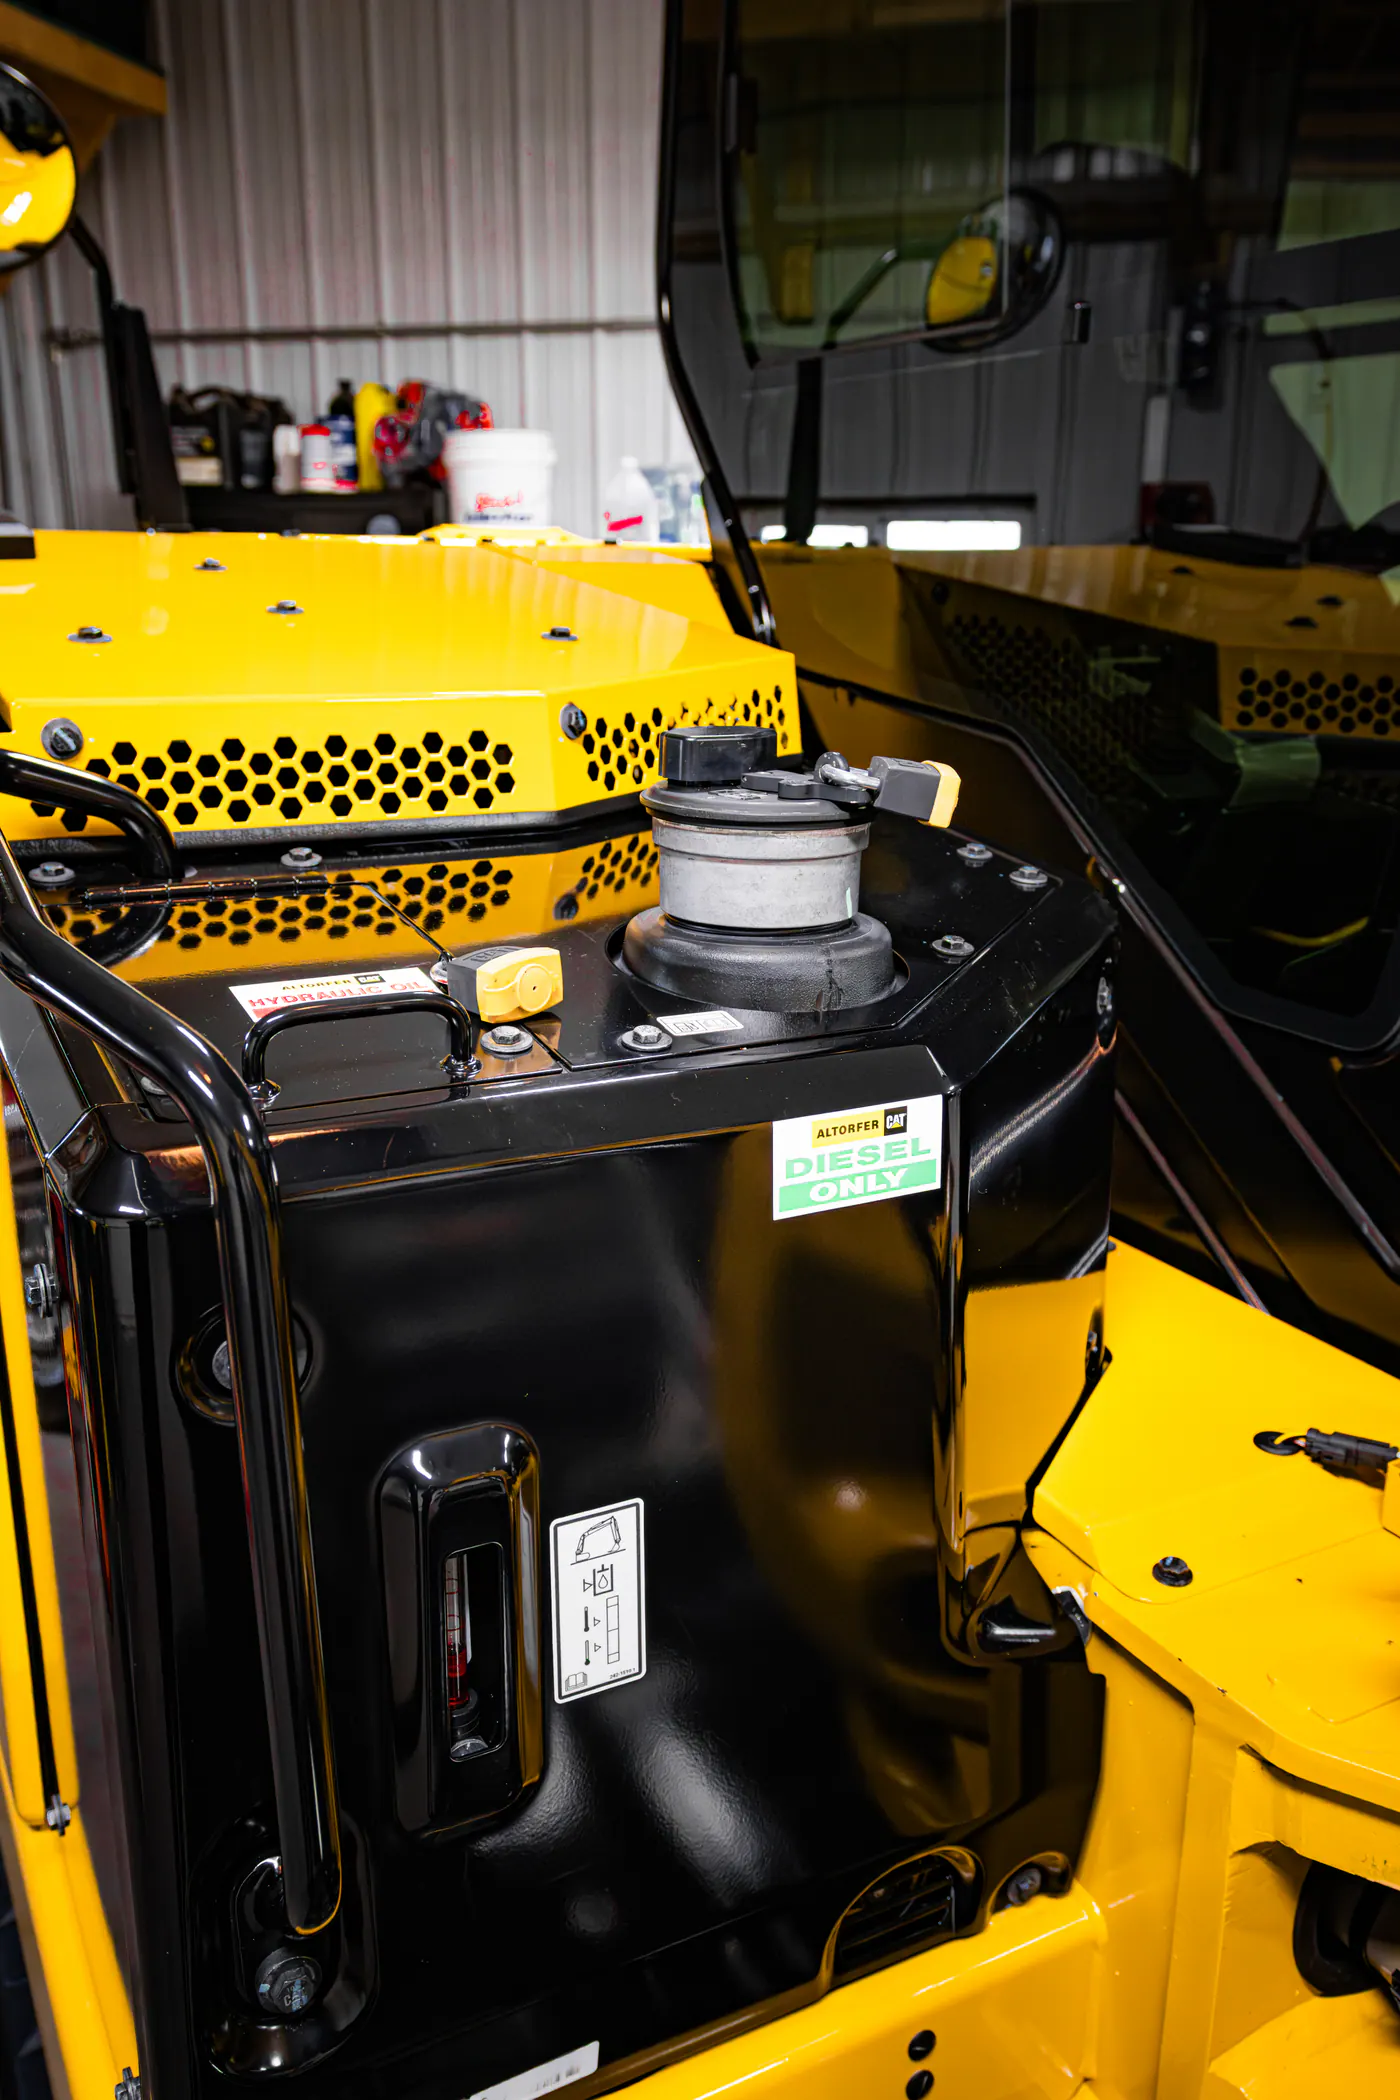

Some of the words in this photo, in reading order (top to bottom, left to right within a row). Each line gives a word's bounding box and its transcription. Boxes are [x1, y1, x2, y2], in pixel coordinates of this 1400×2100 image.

[248, 985, 382, 1007] HYDRAULIC
[390, 981, 428, 991] OIL
[282, 978, 351, 991] ALTORFER
[817, 1119, 879, 1139] ALTORFER
[886, 1113, 907, 1130] CAT
[785, 1137, 931, 1180] DIESEL
[809, 1168, 908, 1202] ONLY
